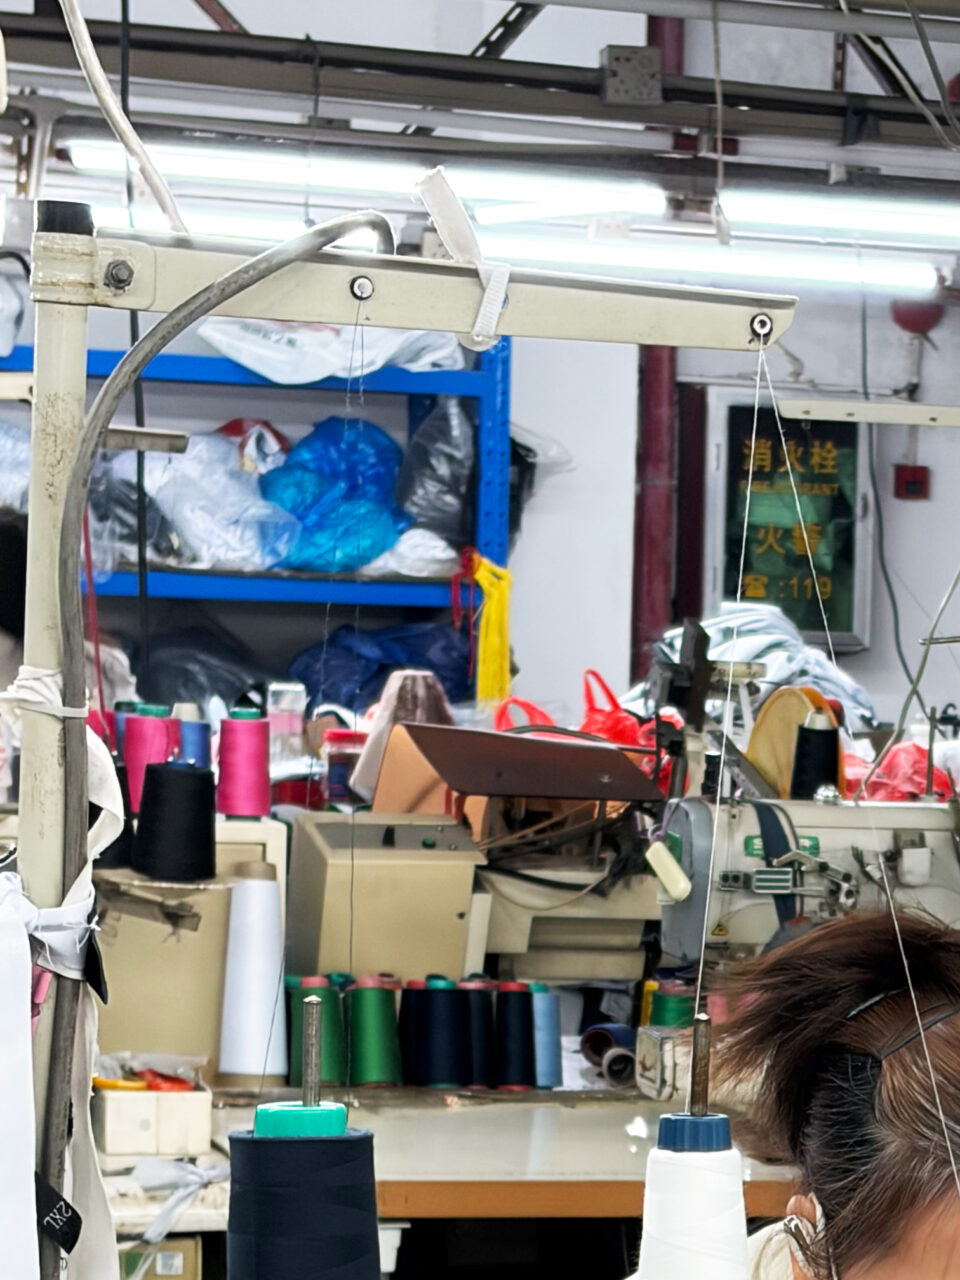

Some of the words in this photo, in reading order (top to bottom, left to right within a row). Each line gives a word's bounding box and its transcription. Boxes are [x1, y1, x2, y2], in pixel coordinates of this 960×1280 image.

[742, 438, 839, 474] 消火栓
[755, 522, 823, 556] 火警
[43, 1200, 72, 1229] 2XL
